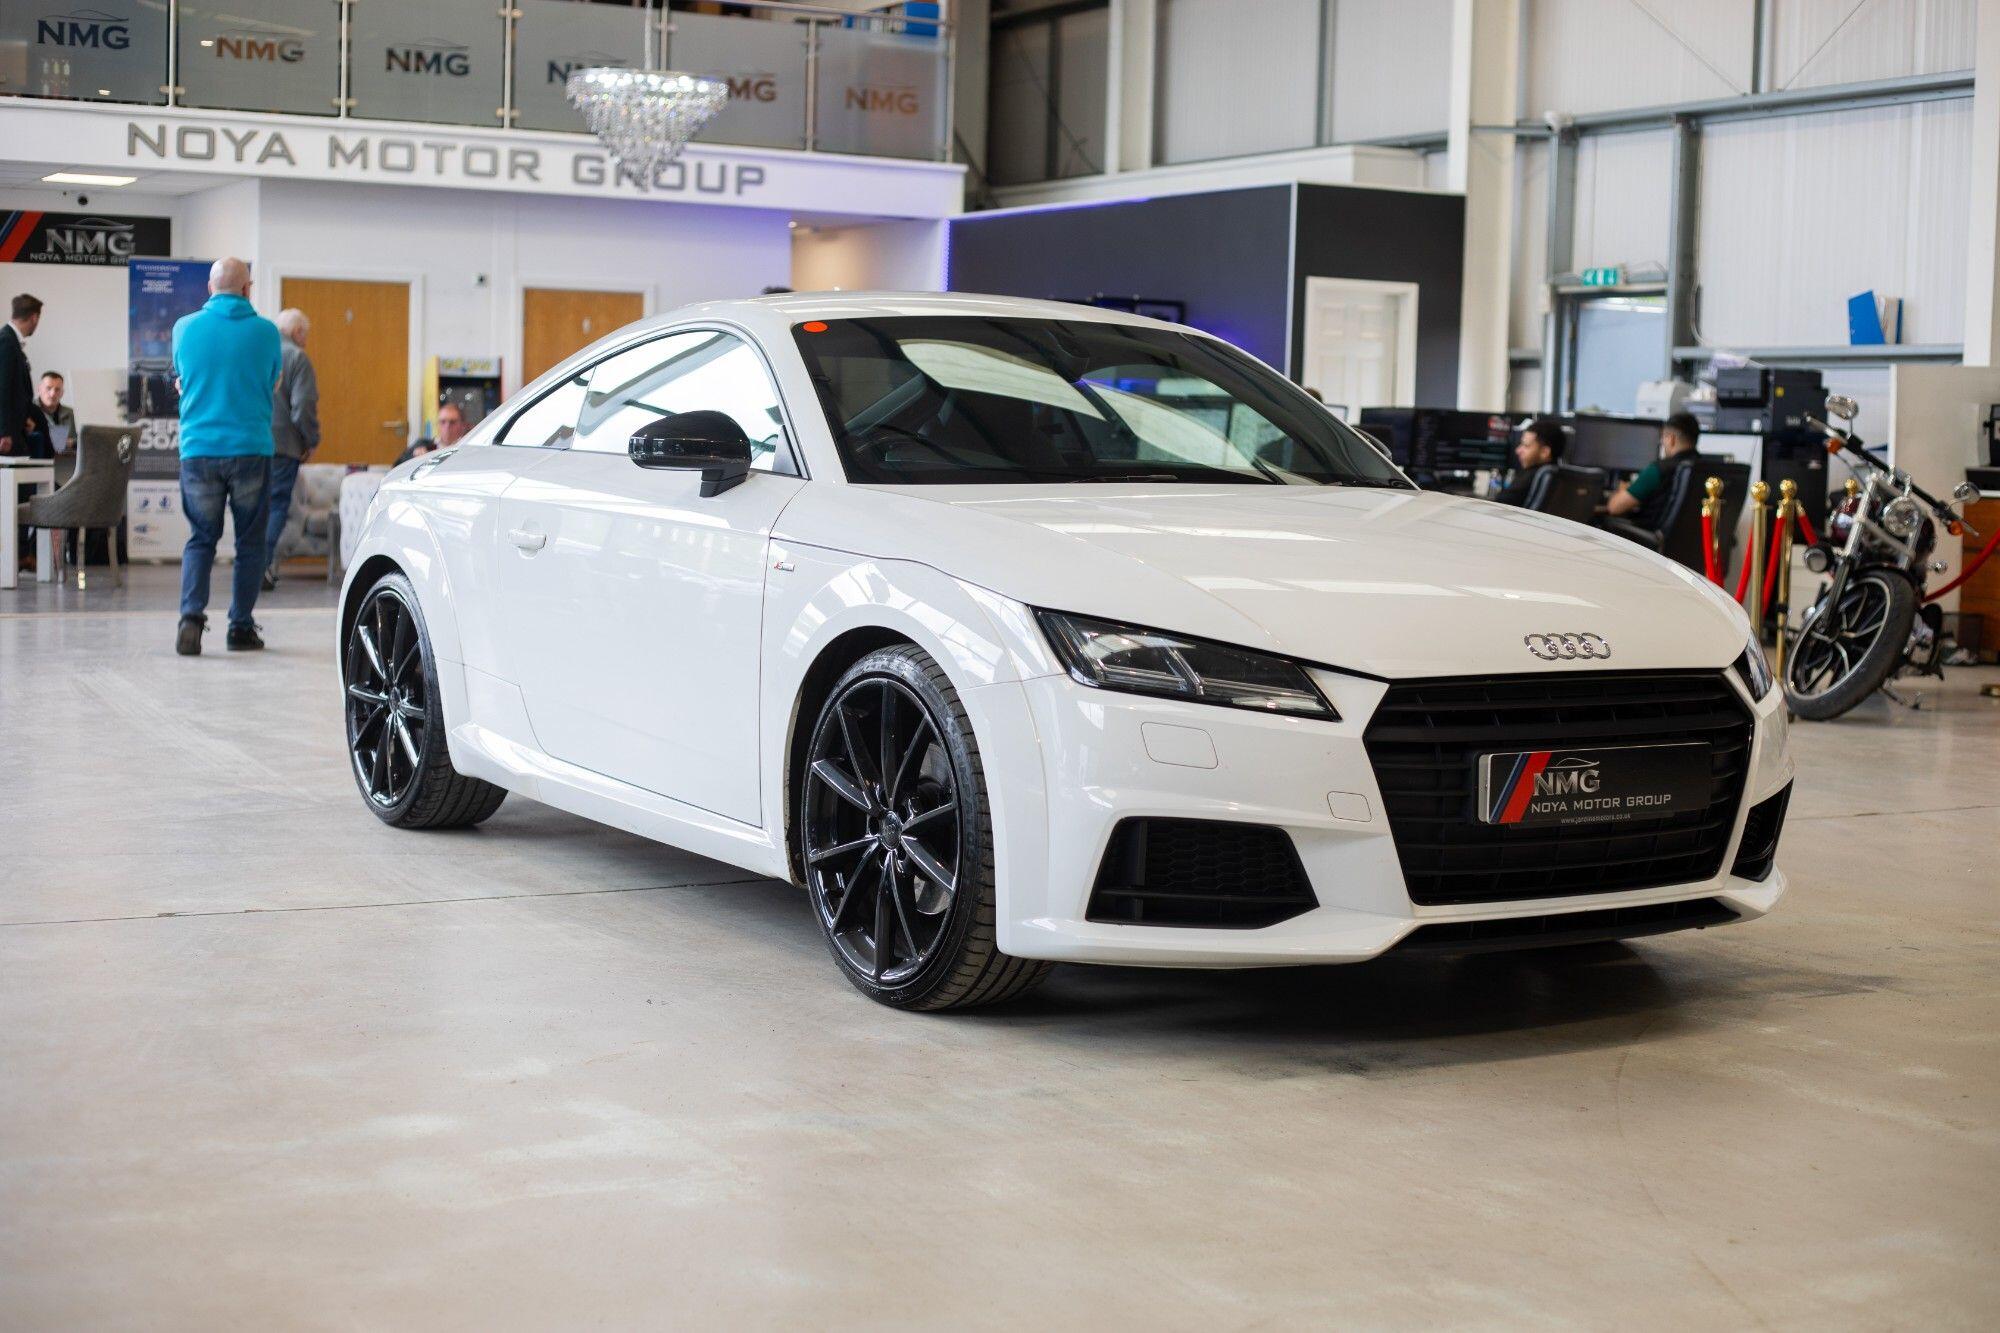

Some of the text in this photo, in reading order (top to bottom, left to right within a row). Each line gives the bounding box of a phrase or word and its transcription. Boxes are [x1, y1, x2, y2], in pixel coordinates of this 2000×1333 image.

[37, 20, 130, 50] NMG
[216, 37, 304, 63] NMG
[385, 47, 470, 77] NMG
[726, 76, 777, 102] MG
[844, 86, 919, 114] NMG
[127, 122, 766, 196] NOYA MOTOR GROUP
[45, 228, 136, 256] NMG
[29, 252, 61, 263] NOYA
[65, 254, 107, 265] MOTOR
[1532, 769, 1600, 797] NMG
[1531, 794, 1672, 813] NOYA MOTOR GROUP
